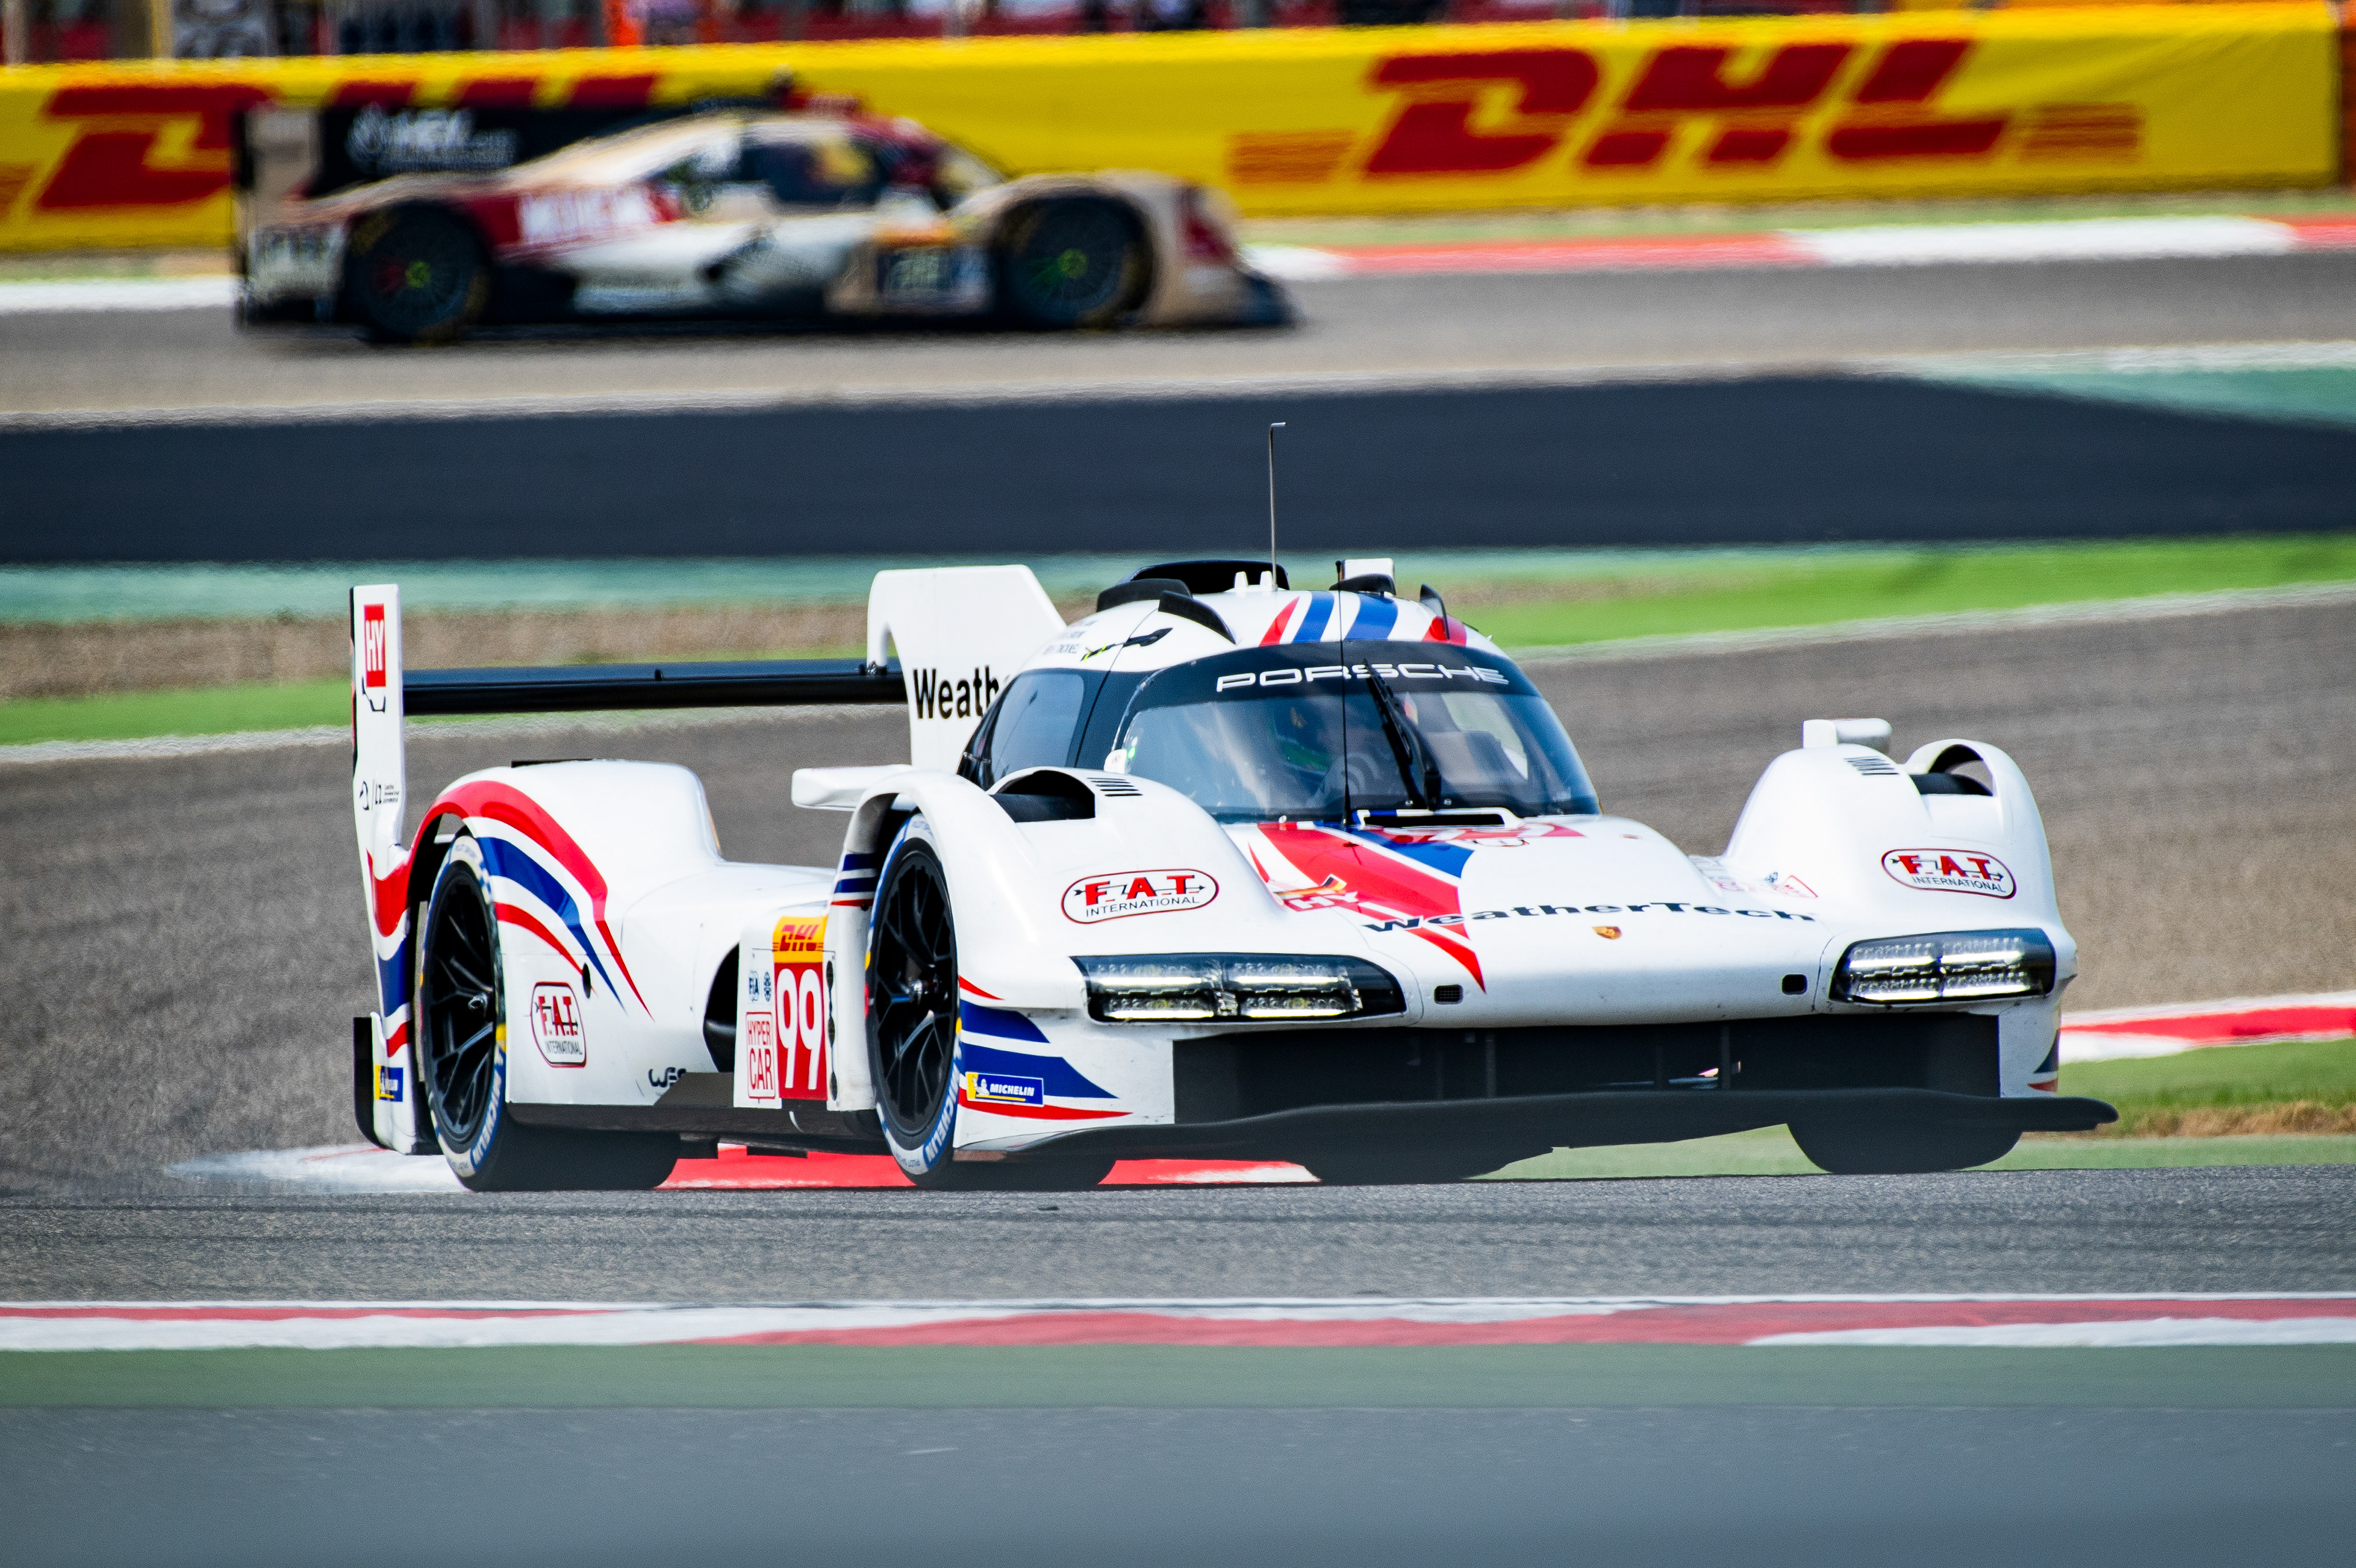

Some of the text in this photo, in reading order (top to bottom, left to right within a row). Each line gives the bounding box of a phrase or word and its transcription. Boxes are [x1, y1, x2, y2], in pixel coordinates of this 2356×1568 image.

[1367, 40, 2005, 172] DHL
[366, 620, 385, 672] HY
[1217, 663, 1509, 693] PORSCHE
[1912, 877, 2006, 893] INTERNATIONAL
[1086, 896, 1200, 917] INTERNATIONAL
[1363, 902, 1815, 932] WeatherTech
[780, 924, 819, 951] DHL
[747, 1021, 772, 1045] HYPER
[777, 968, 823, 1090] 99
[750, 1048, 773, 1090] CAR
[990, 1083, 1034, 1096] MICHELIN
[925, 1061, 961, 1163] MICHELIN
